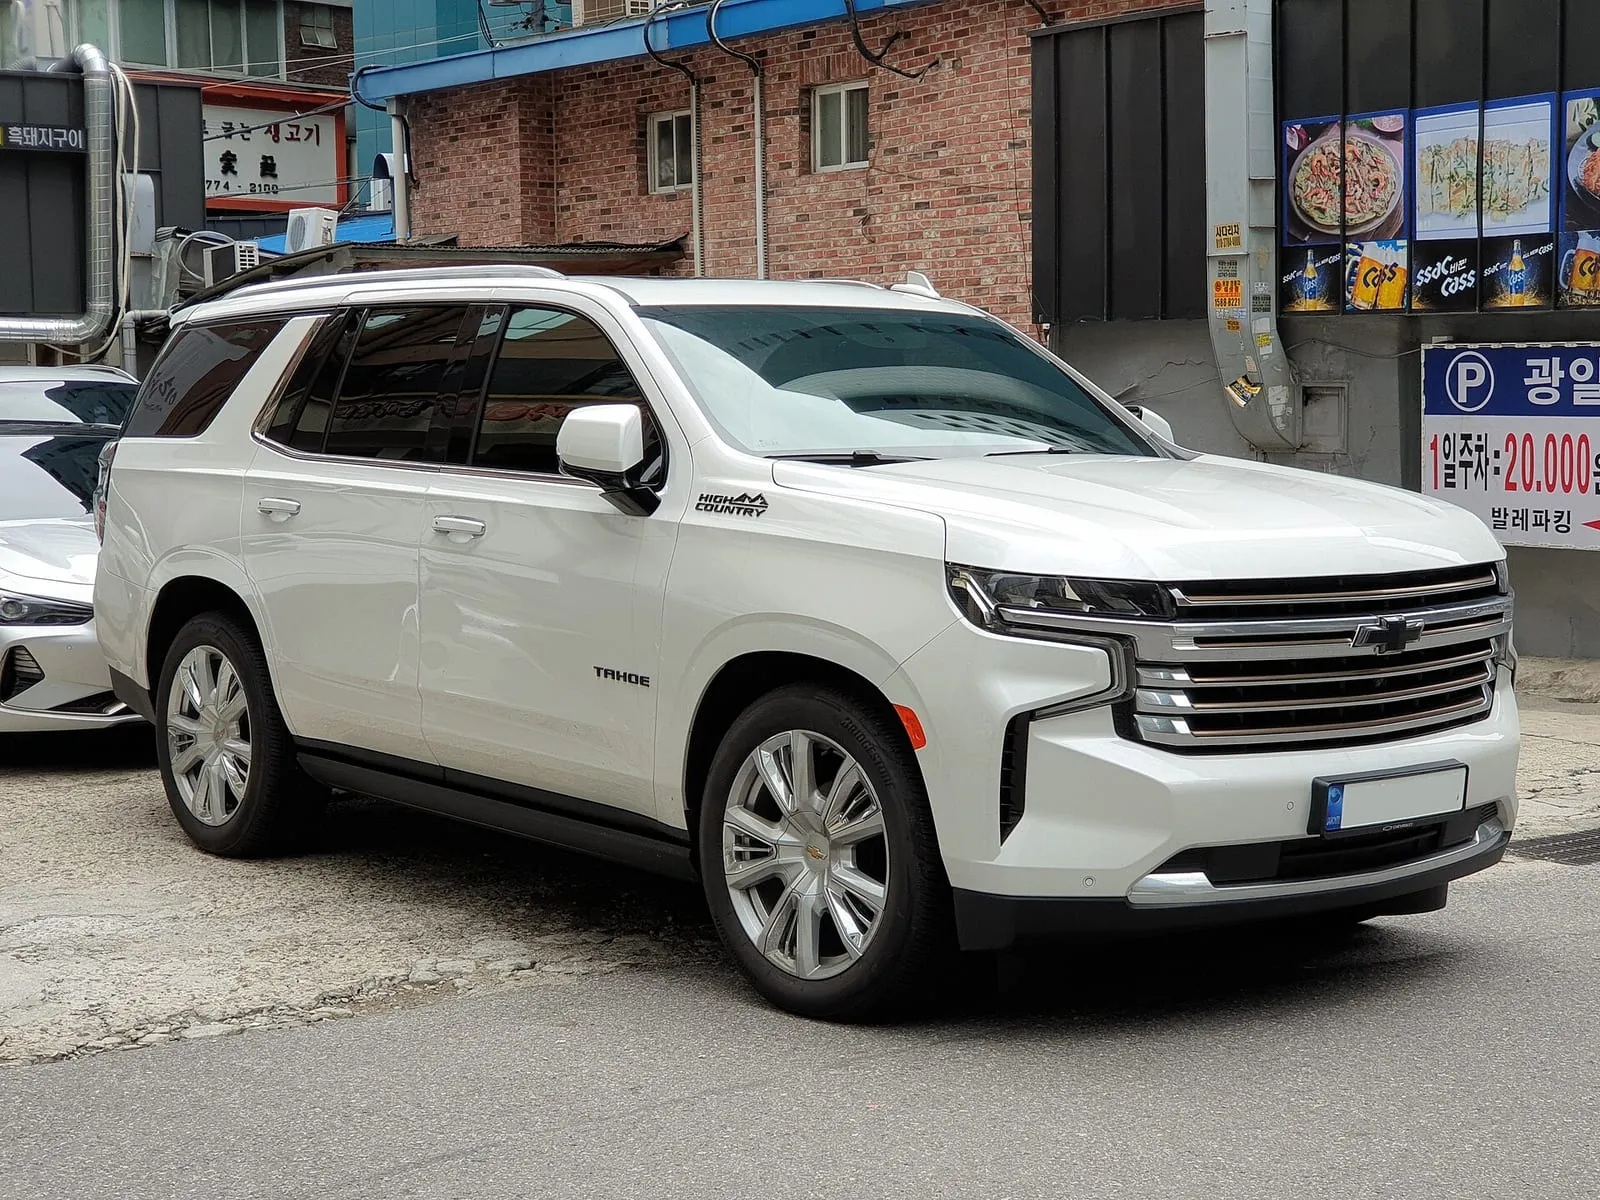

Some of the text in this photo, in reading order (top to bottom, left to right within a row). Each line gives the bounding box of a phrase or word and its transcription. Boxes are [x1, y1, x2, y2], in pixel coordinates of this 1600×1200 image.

[8, 126, 82, 149] 흑돼지구이
[698, 493, 735, 505] HIGH
[694, 502, 767, 518] COUNTRY
[1491, 507, 1572, 534] 발레파킹
[593, 666, 650, 687] TAHOE
